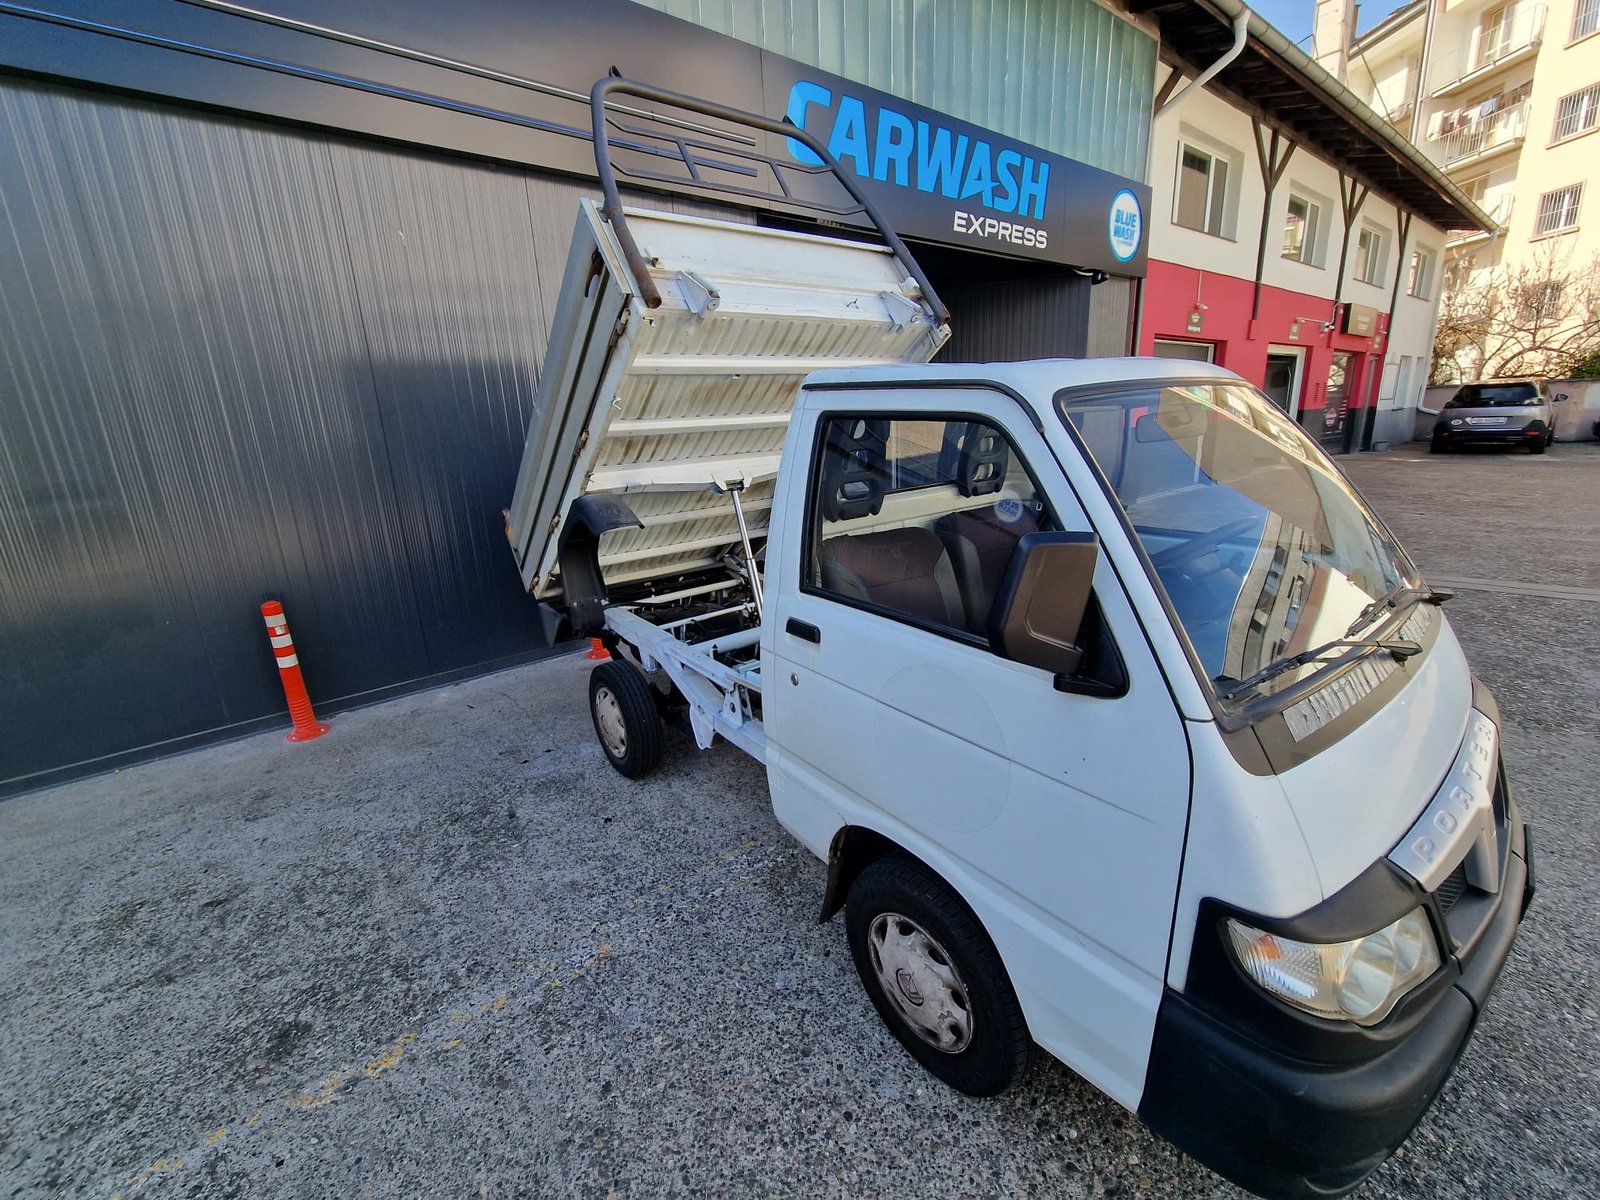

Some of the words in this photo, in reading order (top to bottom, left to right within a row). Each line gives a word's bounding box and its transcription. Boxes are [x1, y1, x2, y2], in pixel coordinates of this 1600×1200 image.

[786, 80, 1050, 220] CARWASH
[953, 210, 1048, 249] EXPRESS
[1113, 224, 1136, 242] WASH
[1114, 208, 1137, 228] BLUE
[1411, 721, 1492, 864] PORTER
